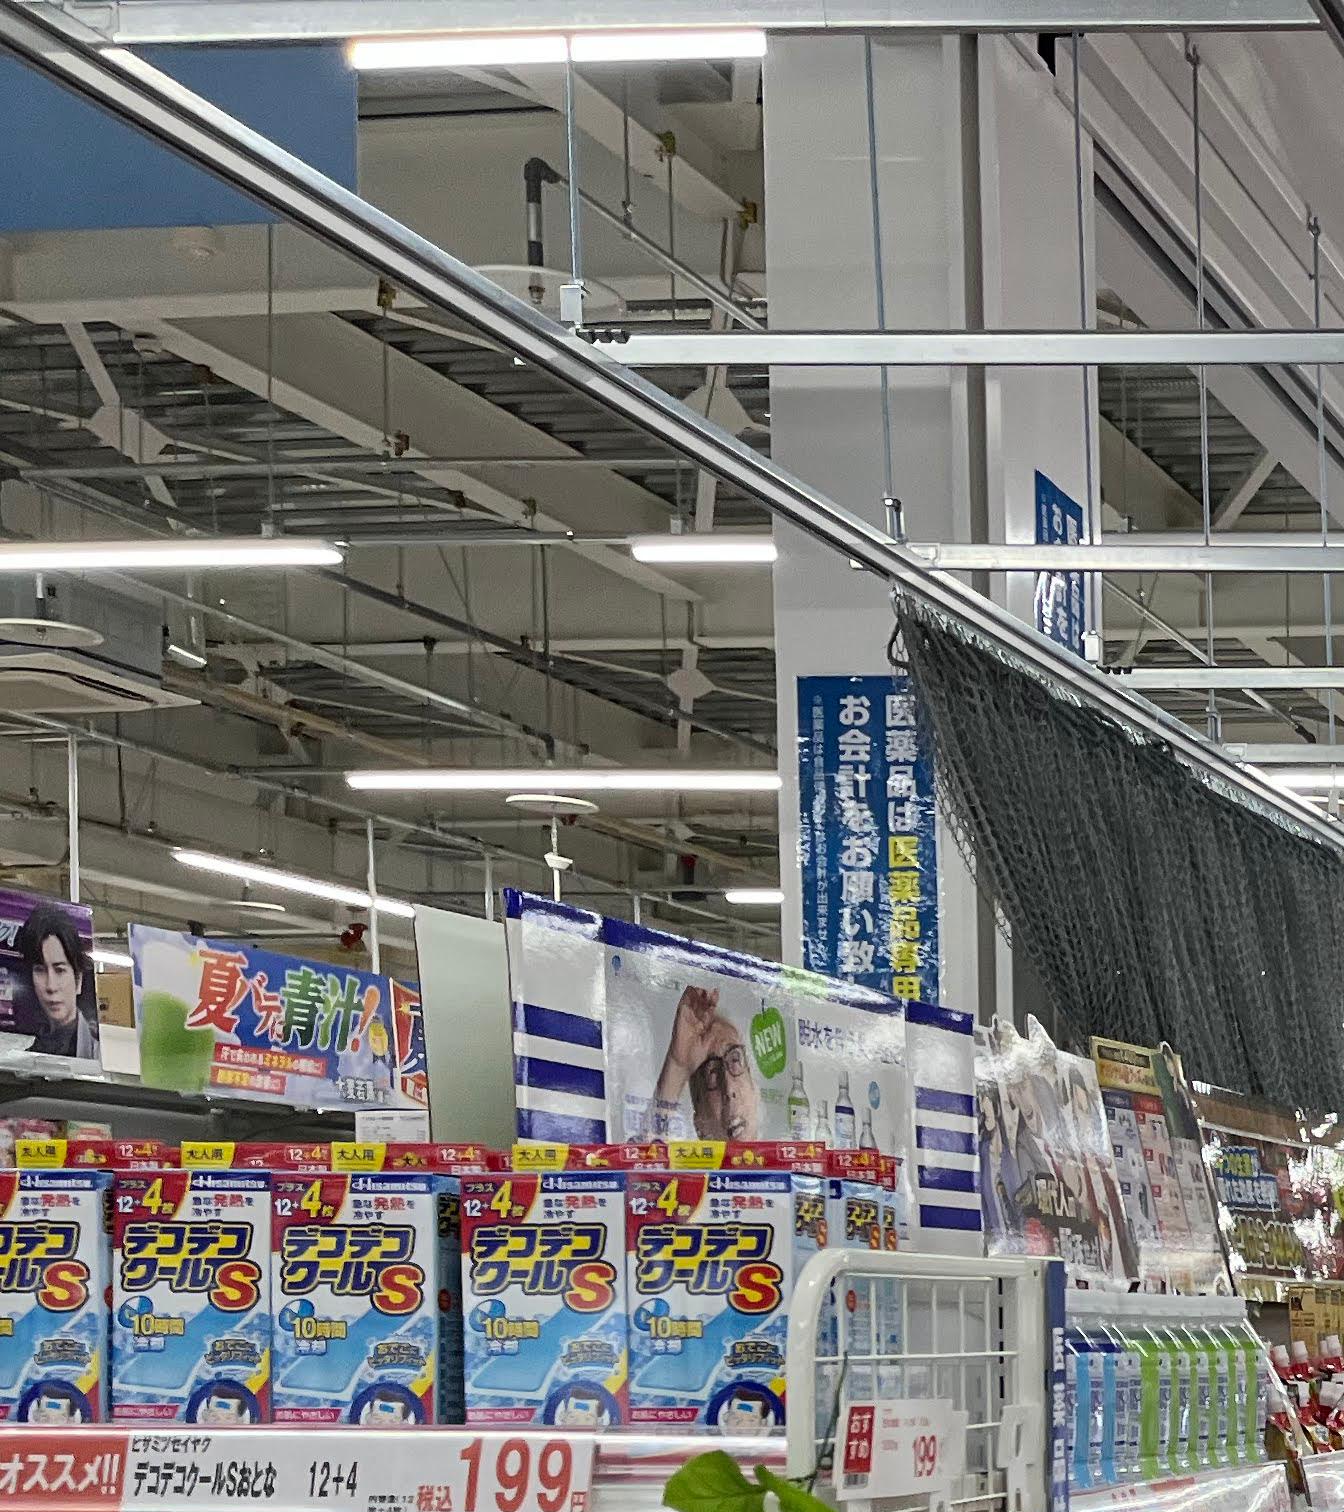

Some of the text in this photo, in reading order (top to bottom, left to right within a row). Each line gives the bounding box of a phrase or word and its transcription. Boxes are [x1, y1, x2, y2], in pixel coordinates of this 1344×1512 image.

[838, 694, 875, 988] お会計をお願い致
[754, 1024, 782, 1056] NEW
[123, 1221, 255, 1260] デコデコ
[283, 1224, 416, 1262] デコデコ
[472, 1223, 607, 1261] デコデコ
[638, 1223, 774, 1261] デコデコ
[121, 1258, 263, 1312] クールS
[280, 1260, 426, 1316] クールS
[471, 1260, 618, 1313] クールS
[636, 1260, 784, 1314] クールS
[132, 1459, 359, 1498] デコデコクールSおとな 12+4
